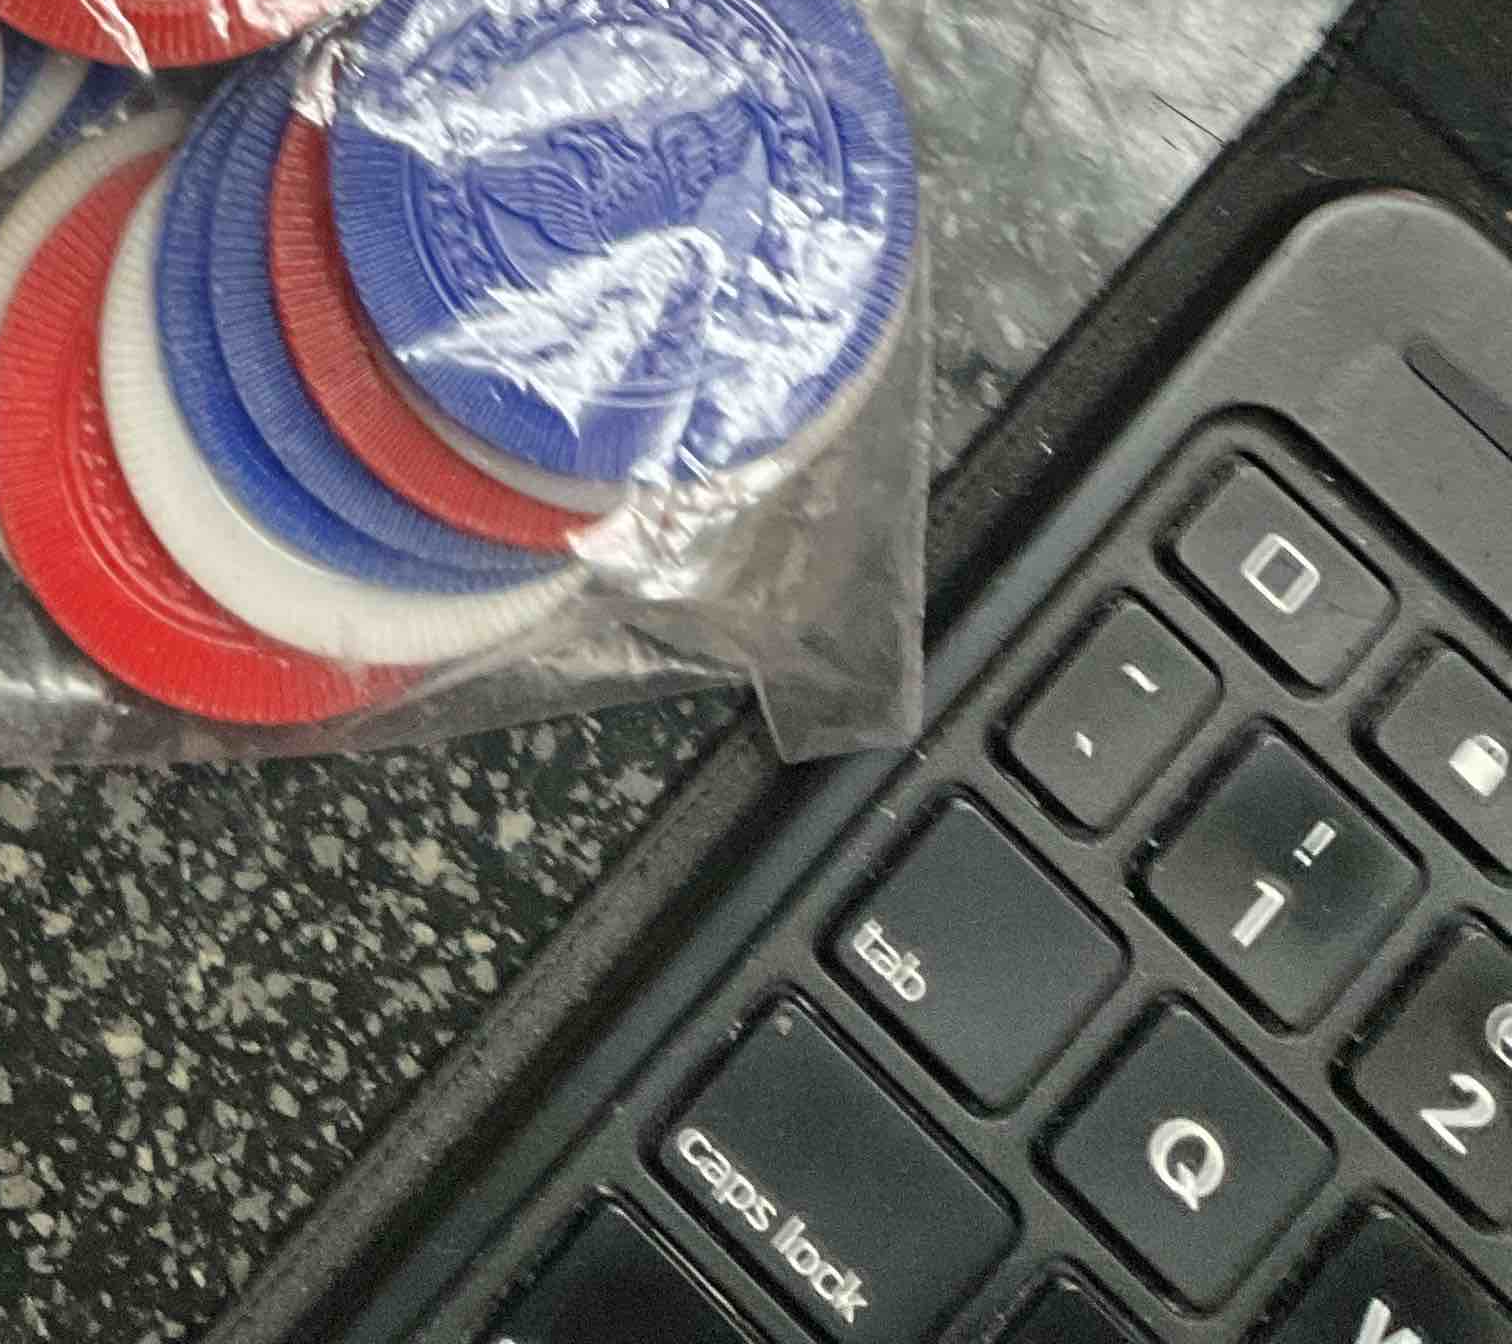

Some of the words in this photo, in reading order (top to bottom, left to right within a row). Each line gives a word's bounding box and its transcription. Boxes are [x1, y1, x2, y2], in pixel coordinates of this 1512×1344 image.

[1293, 820, 1336, 868] !
[1231, 879, 1285, 947] 1
[854, 919, 926, 1002] tab
[1419, 1072, 1496, 1155] 2
[1149, 1118, 1224, 1211] Q
[677, 1128, 777, 1231] caps
[770, 1216, 869, 1324] lock
